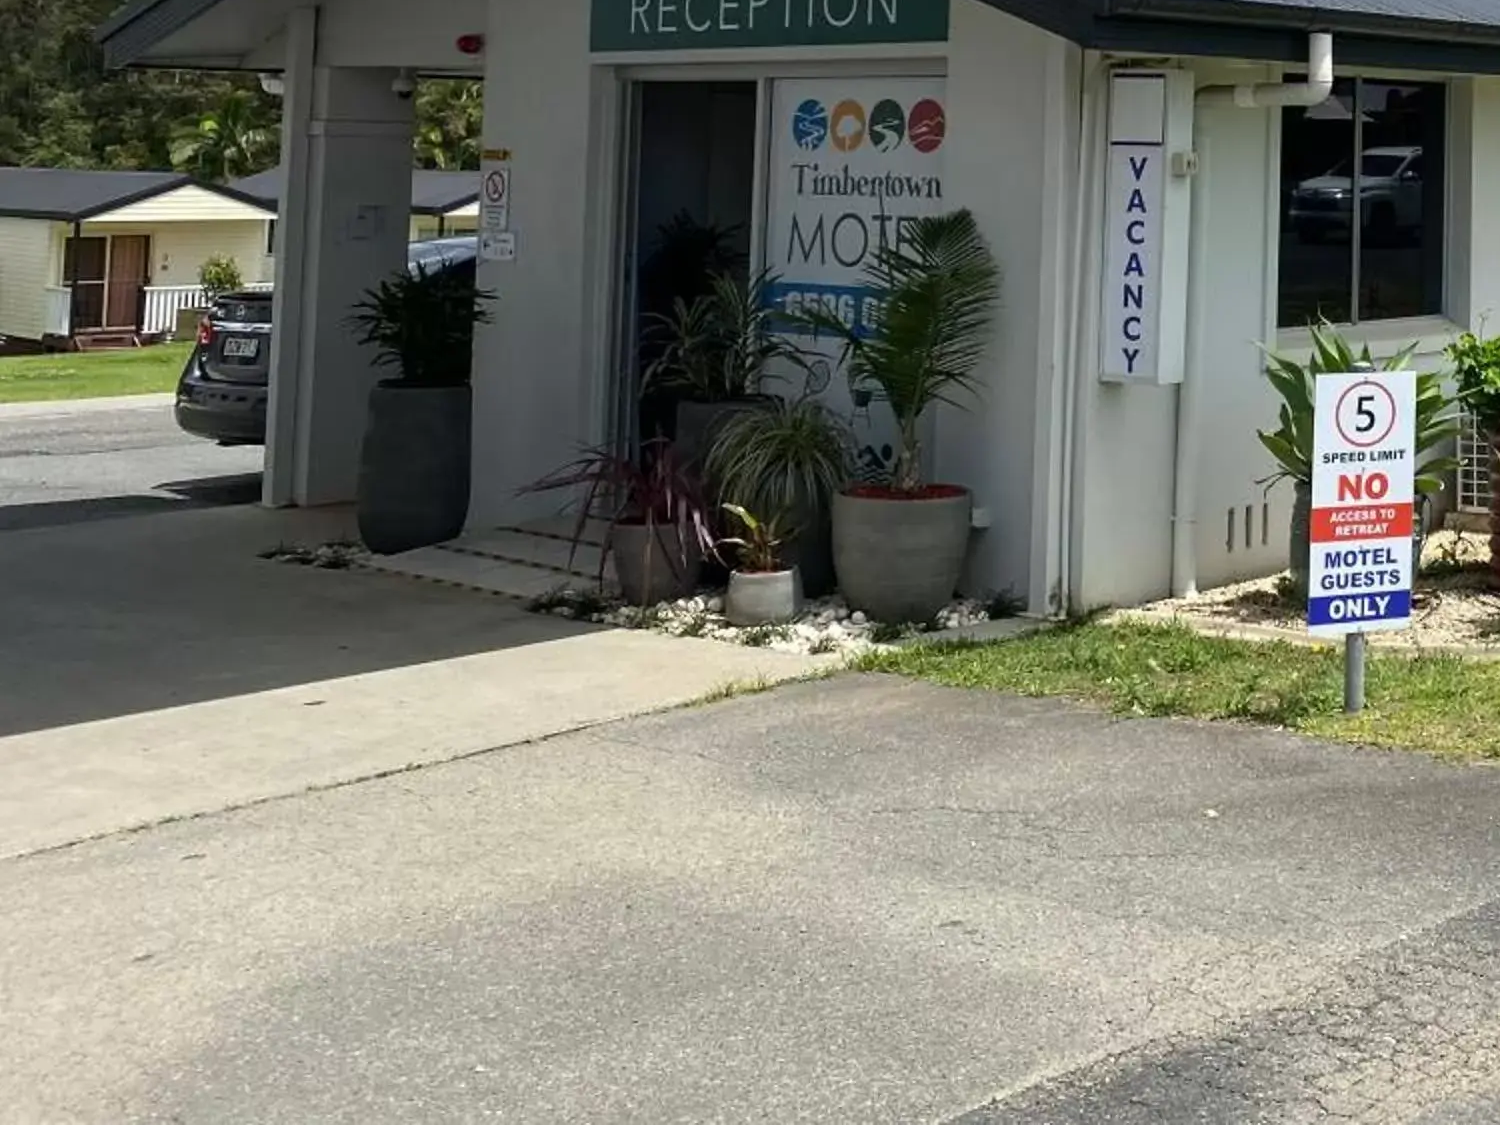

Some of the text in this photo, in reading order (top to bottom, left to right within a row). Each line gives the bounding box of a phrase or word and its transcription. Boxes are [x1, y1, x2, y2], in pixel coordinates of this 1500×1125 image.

[790, 164, 942, 198] Timbertown
[787, 211, 919, 267] MOTE
[1121, 155, 1147, 373] VACANCY
[1355, 395, 1375, 432] 5
[1322, 448, 1405, 463] SPEED LIMIT
[1337, 472, 1388, 501] NO
[1329, 508, 1395, 523] ACCESS TO
[1335, 523, 1388, 535] RETREAT
[1324, 547, 1397, 569] MOTEL
[1320, 569, 1400, 590] GUESTS
[1328, 595, 1390, 619] ONLY
